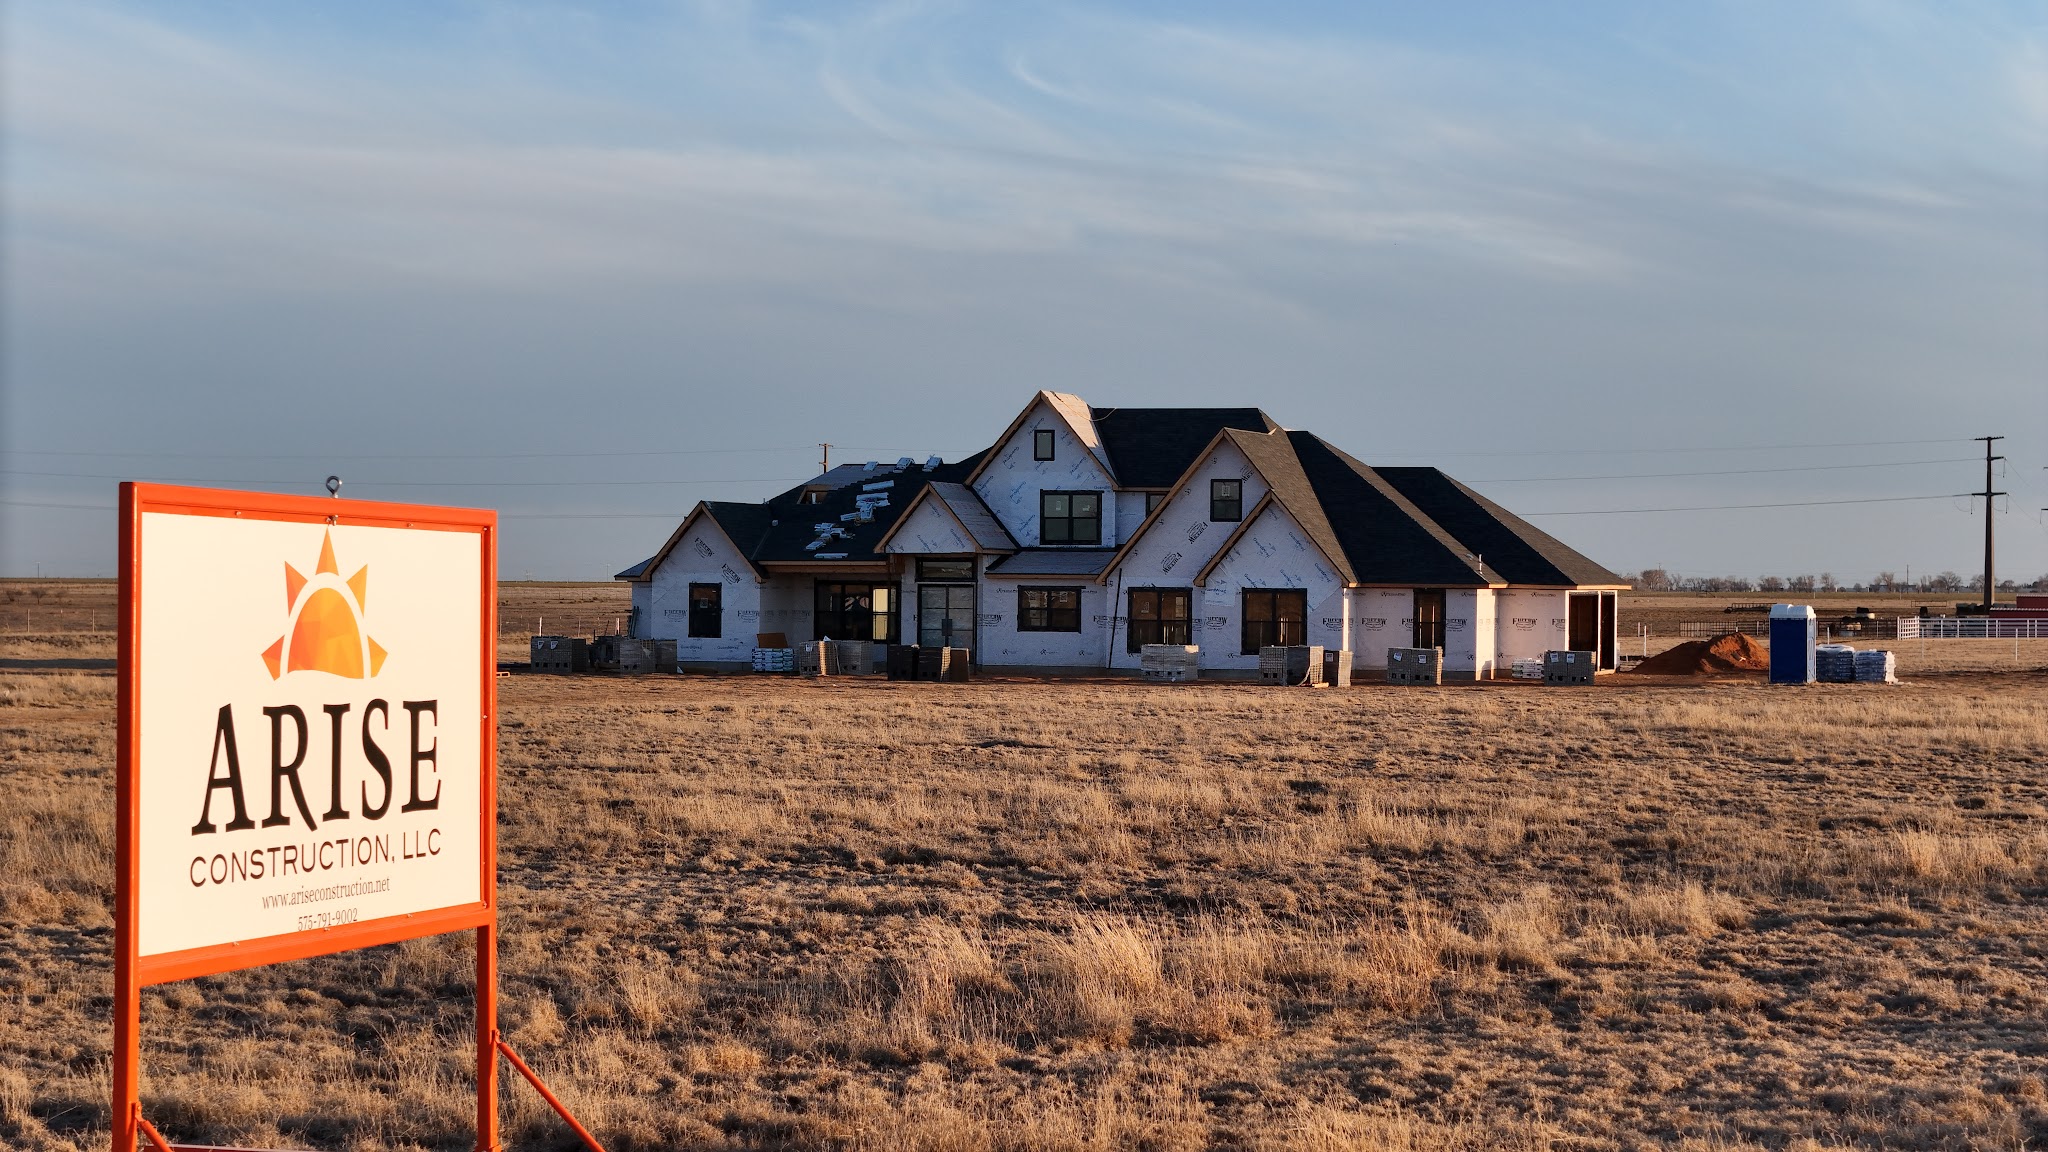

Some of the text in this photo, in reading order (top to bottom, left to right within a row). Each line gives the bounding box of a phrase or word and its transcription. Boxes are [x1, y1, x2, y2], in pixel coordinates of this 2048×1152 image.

[191, 698, 442, 836] ARISE
[190, 828, 442, 888] CONSTRUCTION, LLC
[262, 877, 391, 910] www.ariseconstruction.net
[298, 907, 358, 932] 575-791-9002
